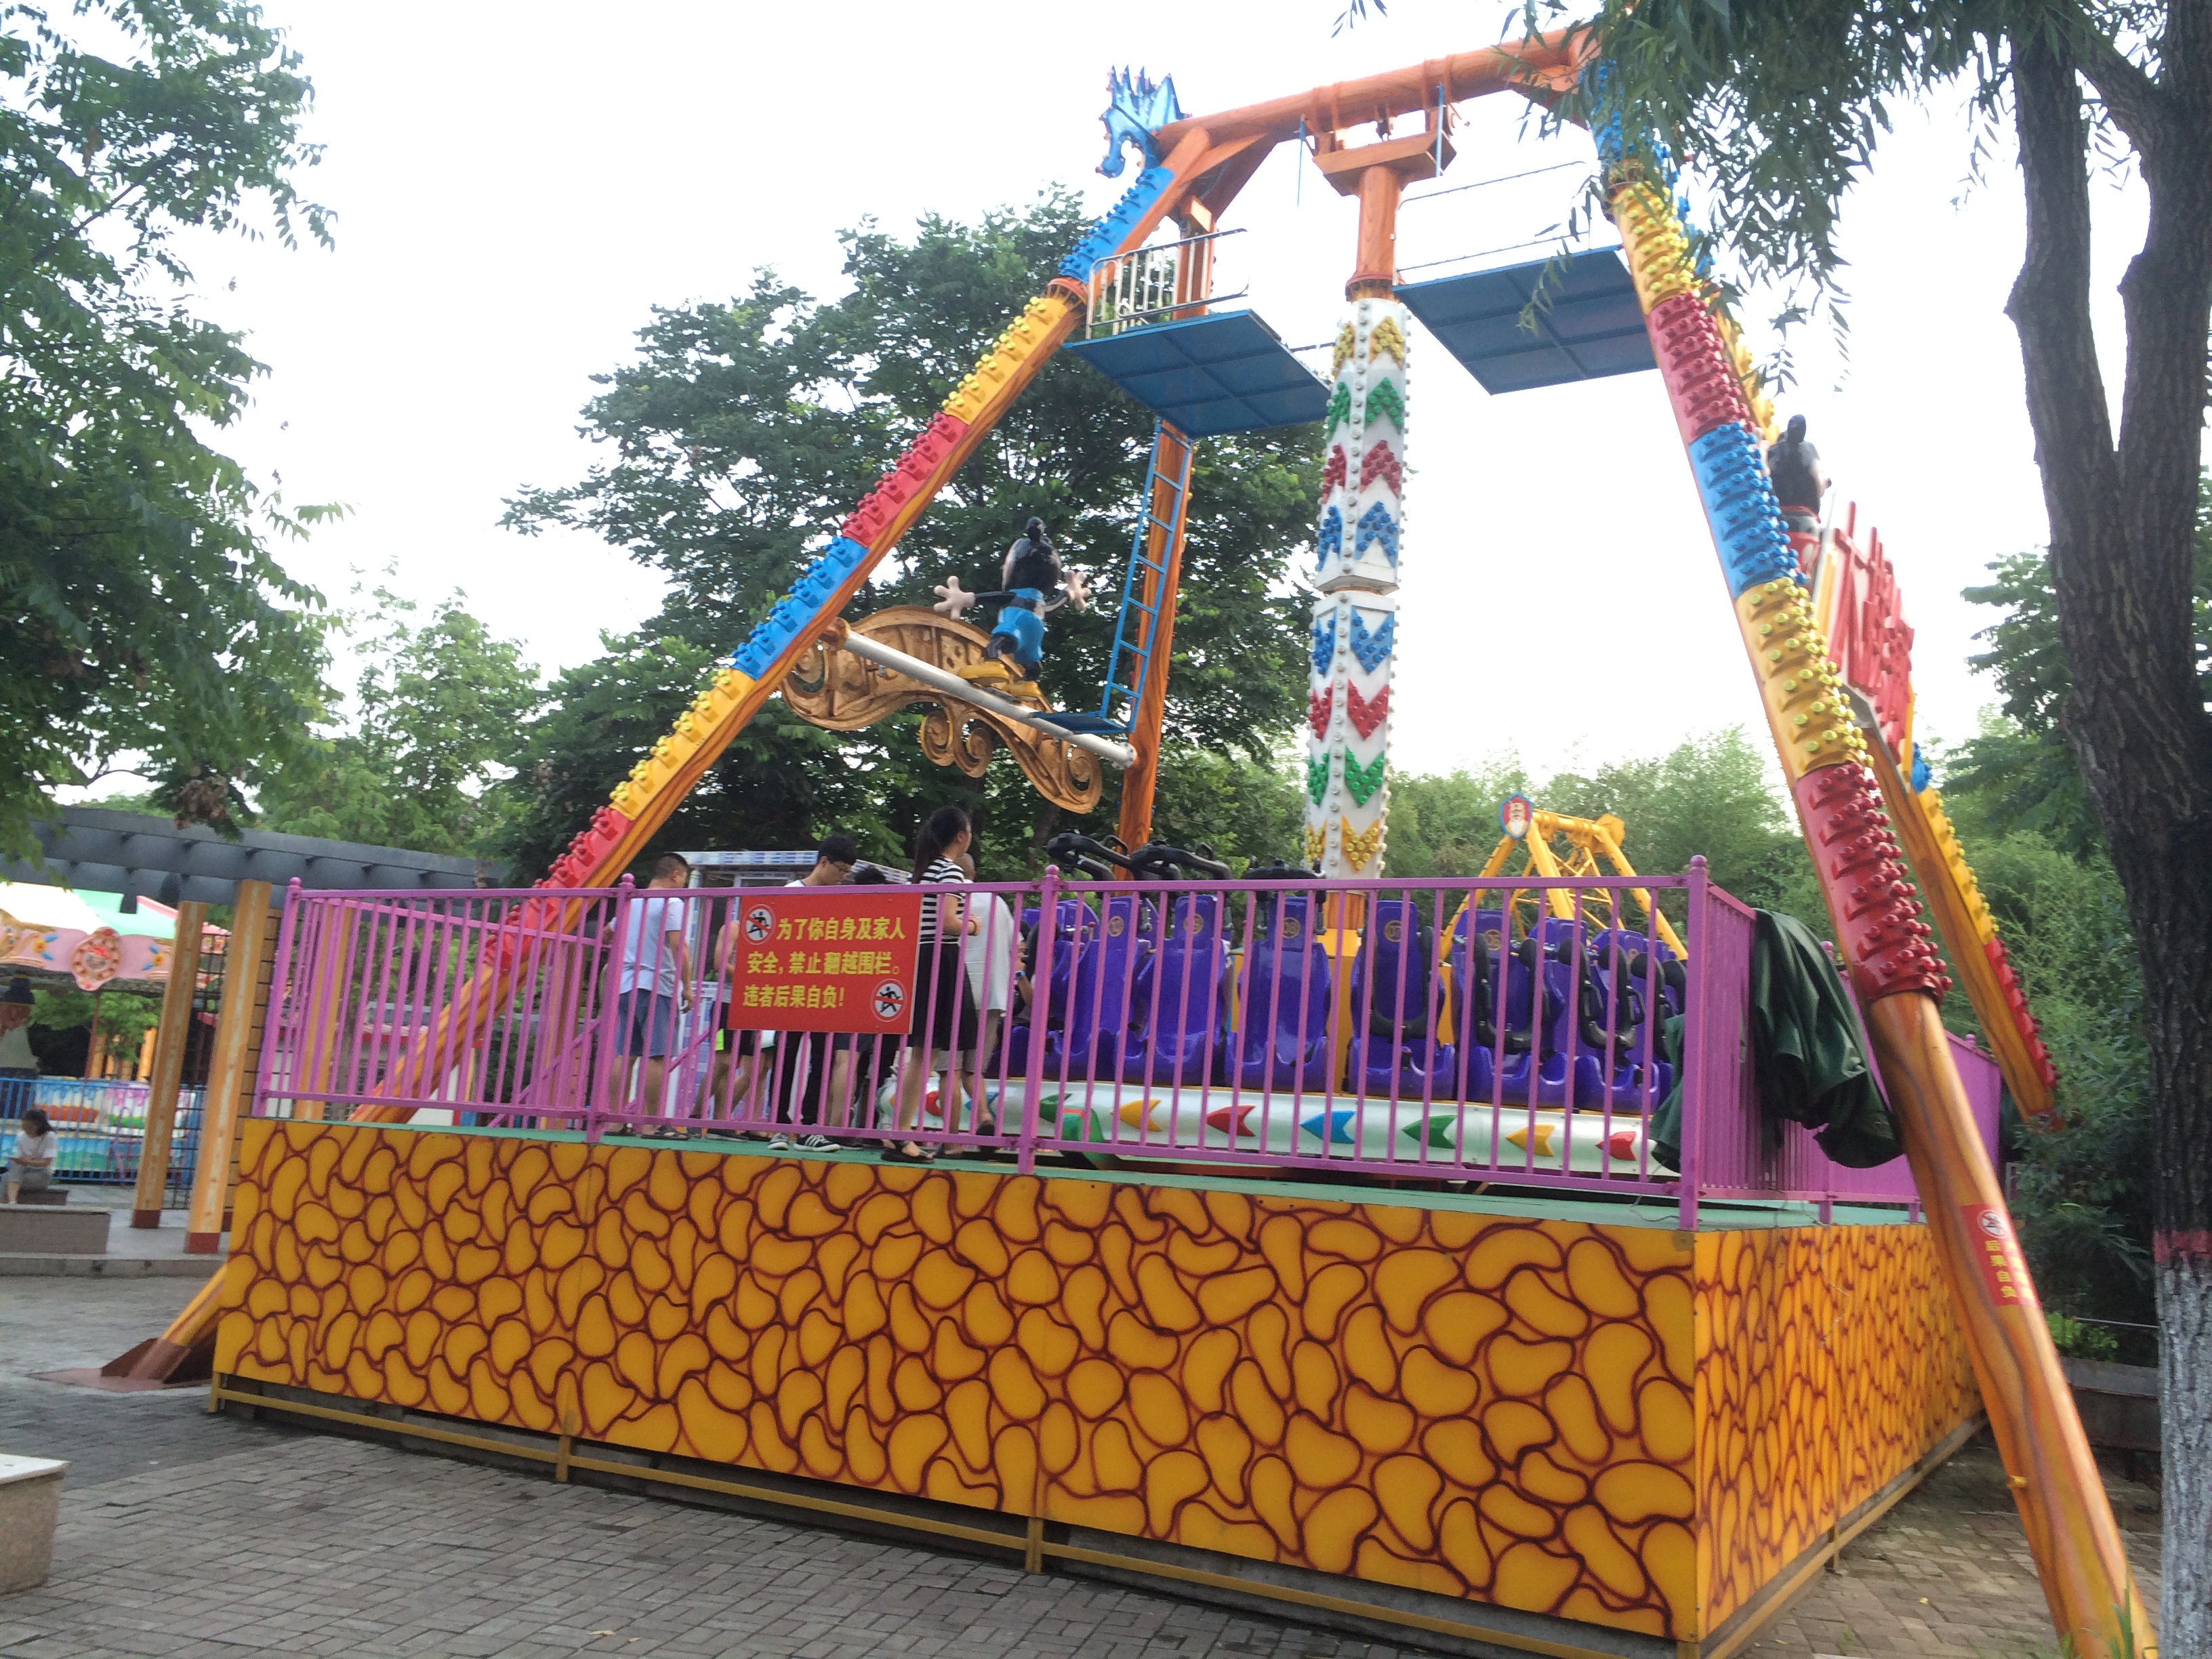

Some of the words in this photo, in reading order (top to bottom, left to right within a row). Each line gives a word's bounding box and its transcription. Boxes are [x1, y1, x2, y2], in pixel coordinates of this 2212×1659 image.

[777, 917, 906, 941] 为了你自身及家人
[1984, 1240, 2018, 1298] 后果自负
